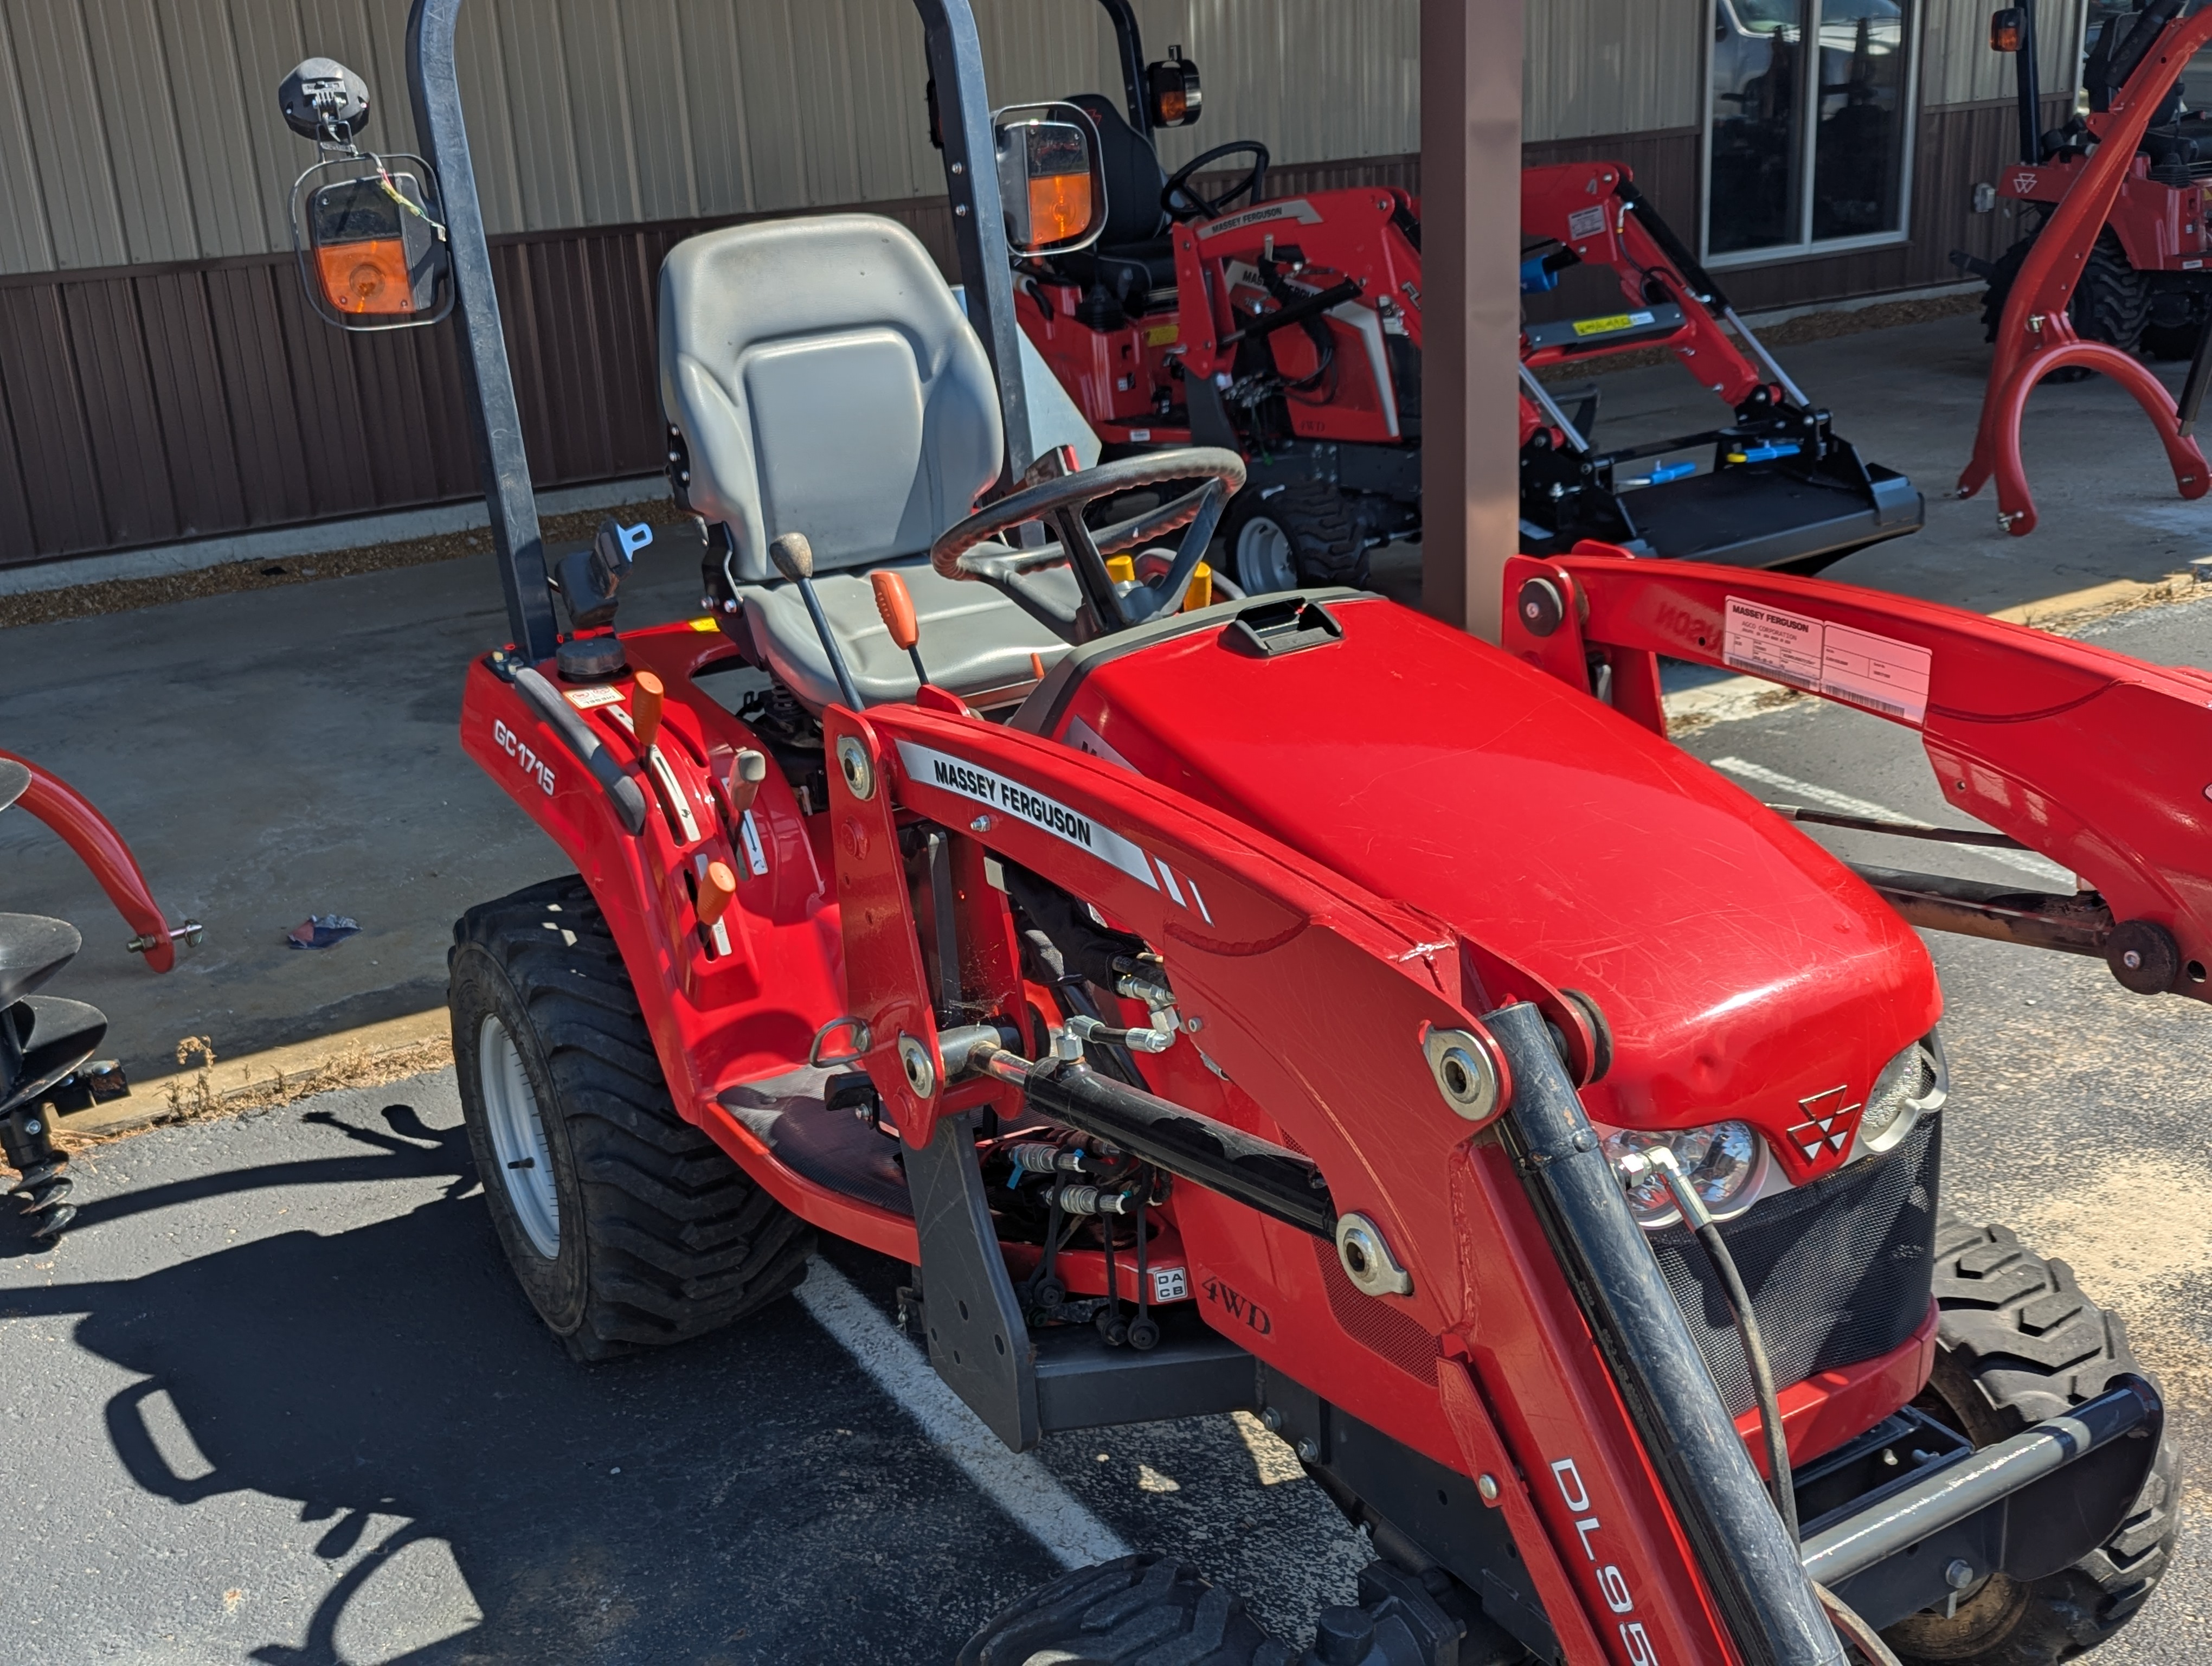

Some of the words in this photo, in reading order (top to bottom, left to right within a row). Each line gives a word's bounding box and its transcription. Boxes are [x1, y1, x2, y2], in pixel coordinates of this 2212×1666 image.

[1212, 217, 1241, 234] MASSEY
[1243, 207, 1282, 223] FERGUSON
[1242, 270, 1264, 286] MAS
[1732, 605, 1765, 620] MASSEY
[1766, 614, 1809, 633] FERGUSON
[1741, 620, 1756, 630] AGCO
[1758, 625, 1797, 641] CORPORATION
[494, 719, 555, 796] GC1715
[933, 759, 996, 802] MASSEY
[1001, 783, 1091, 847] FERGUSON
[1201, 1276, 1271, 1335] 4WD
[1551, 1457, 1659, 1666] DL95
